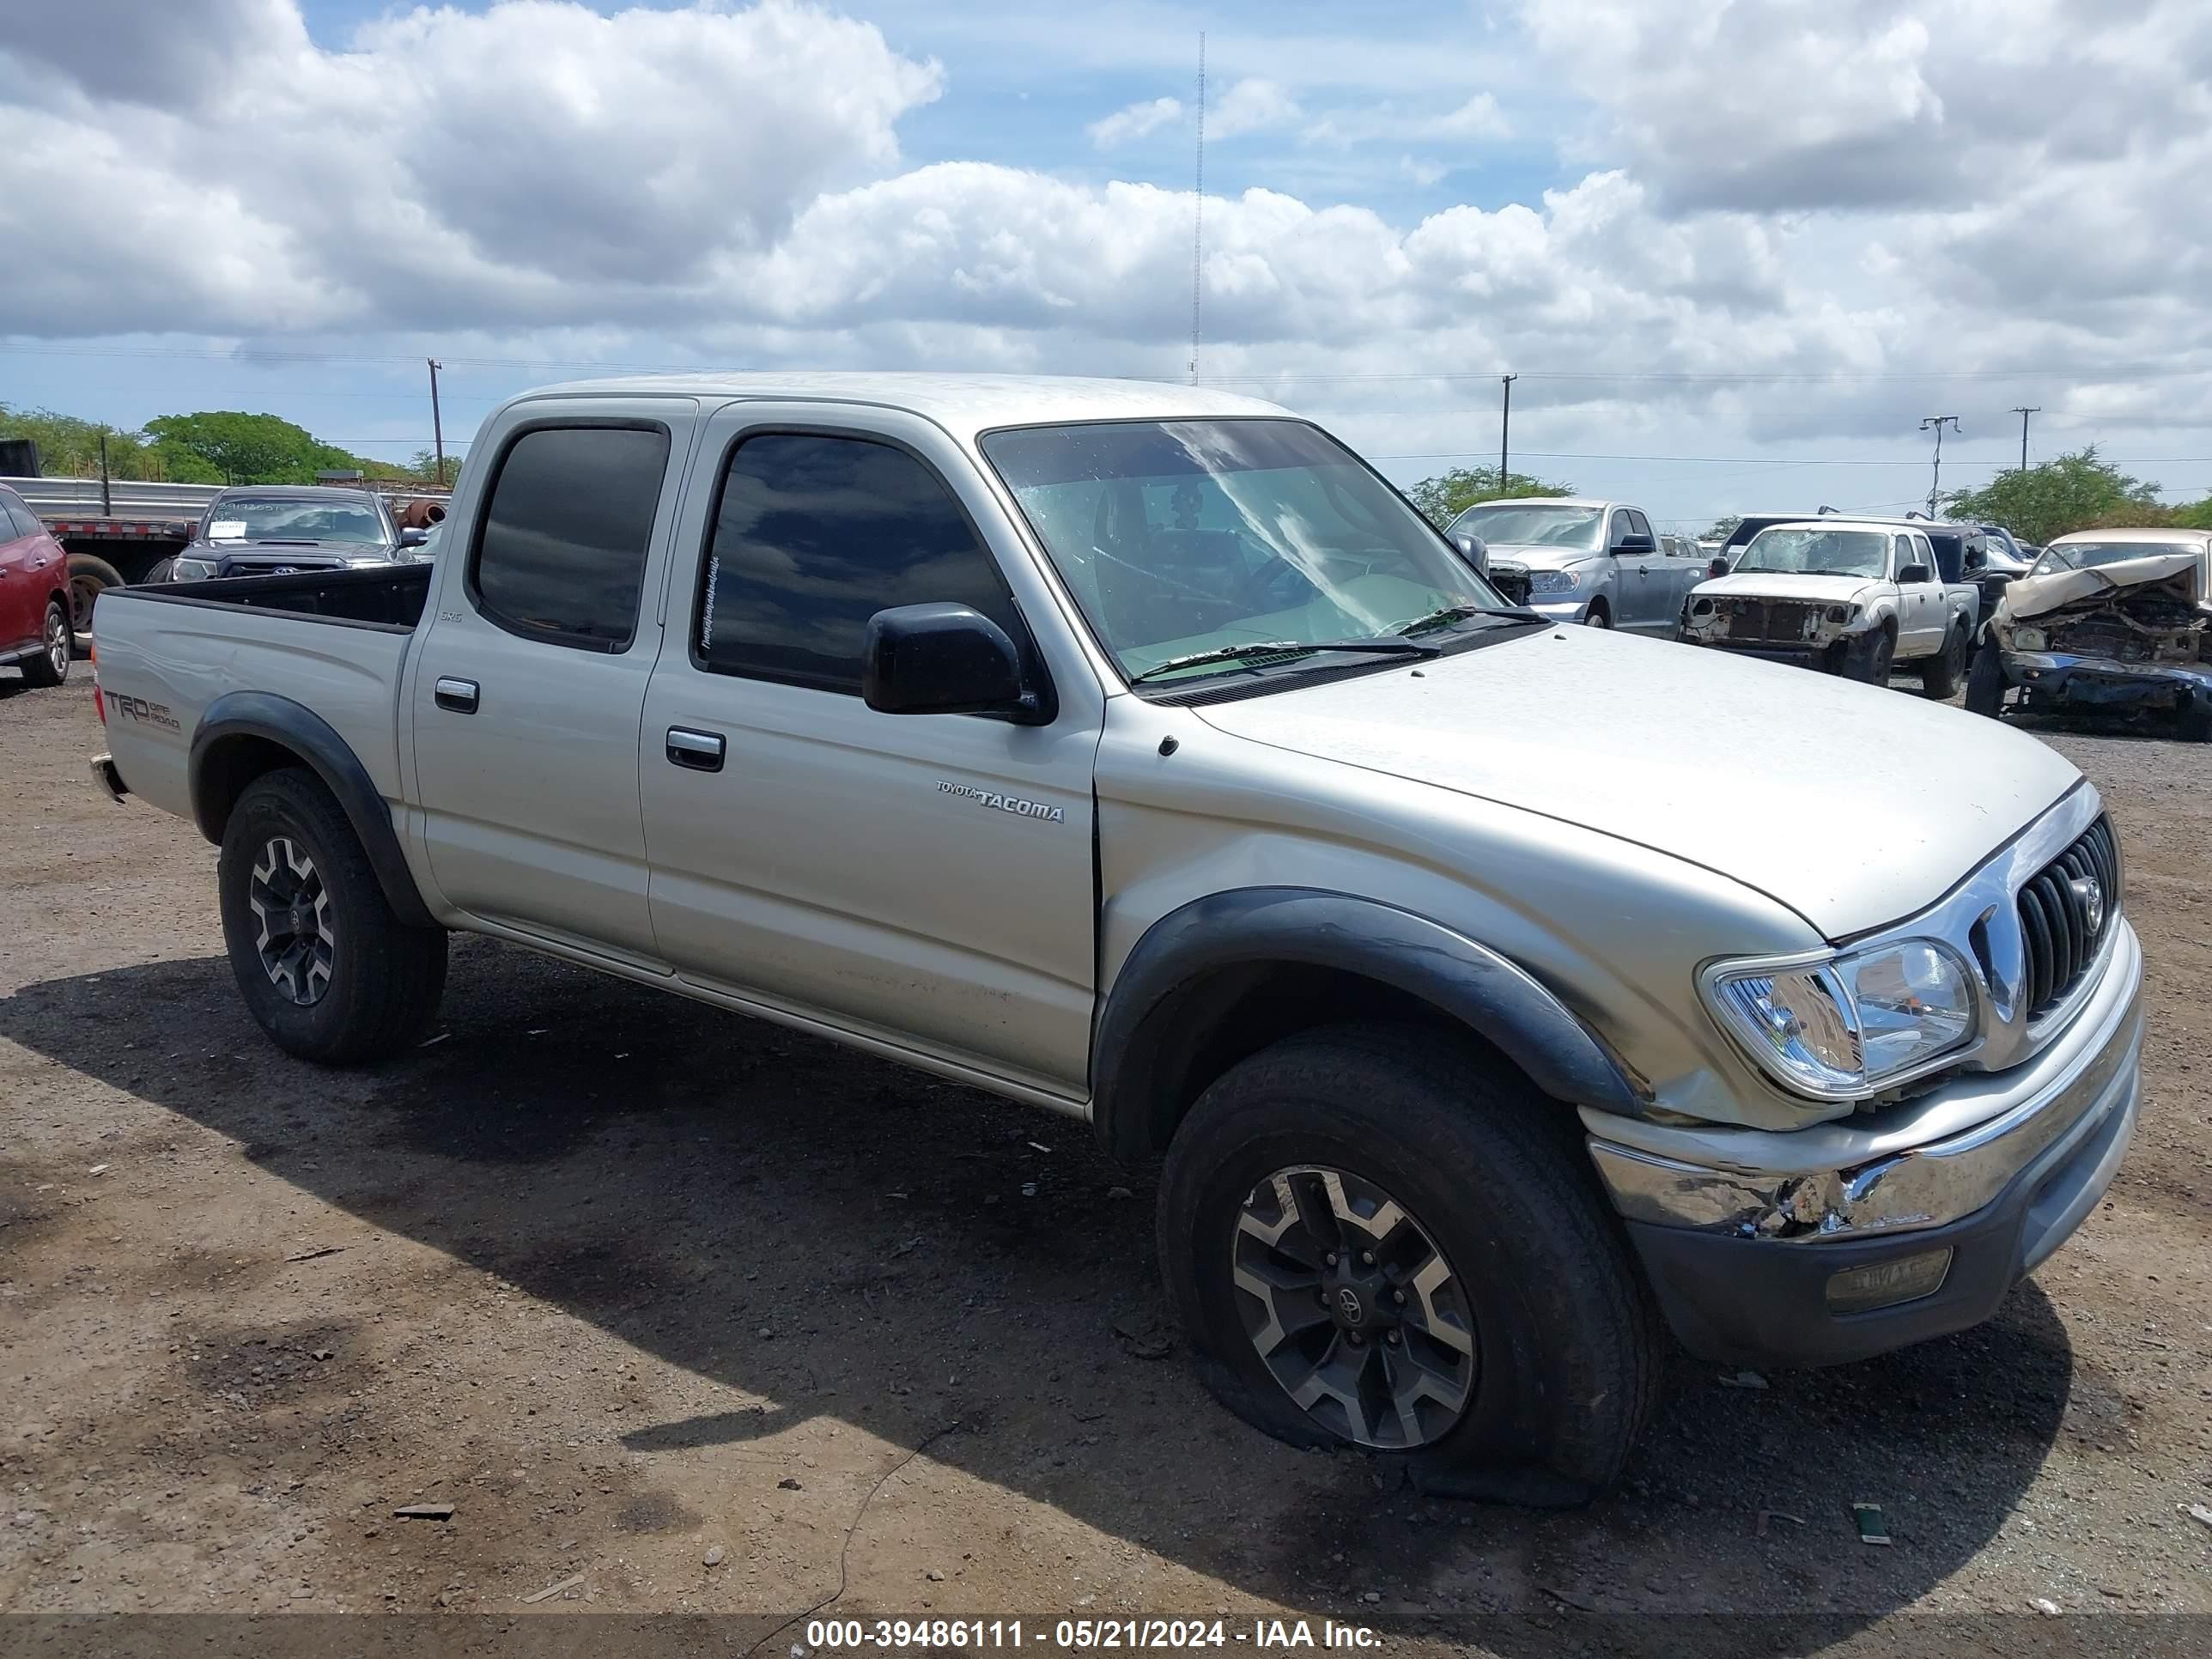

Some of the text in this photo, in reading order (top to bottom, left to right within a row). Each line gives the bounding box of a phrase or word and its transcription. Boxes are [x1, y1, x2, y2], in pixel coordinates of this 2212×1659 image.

[440, 611, 463, 623] SR5
[104, 690, 149, 721] TRD
[149, 702, 171, 714] OFF
[151, 713, 180, 728] ROAD
[936, 780, 1065, 824] TOYOTA TACOMA
